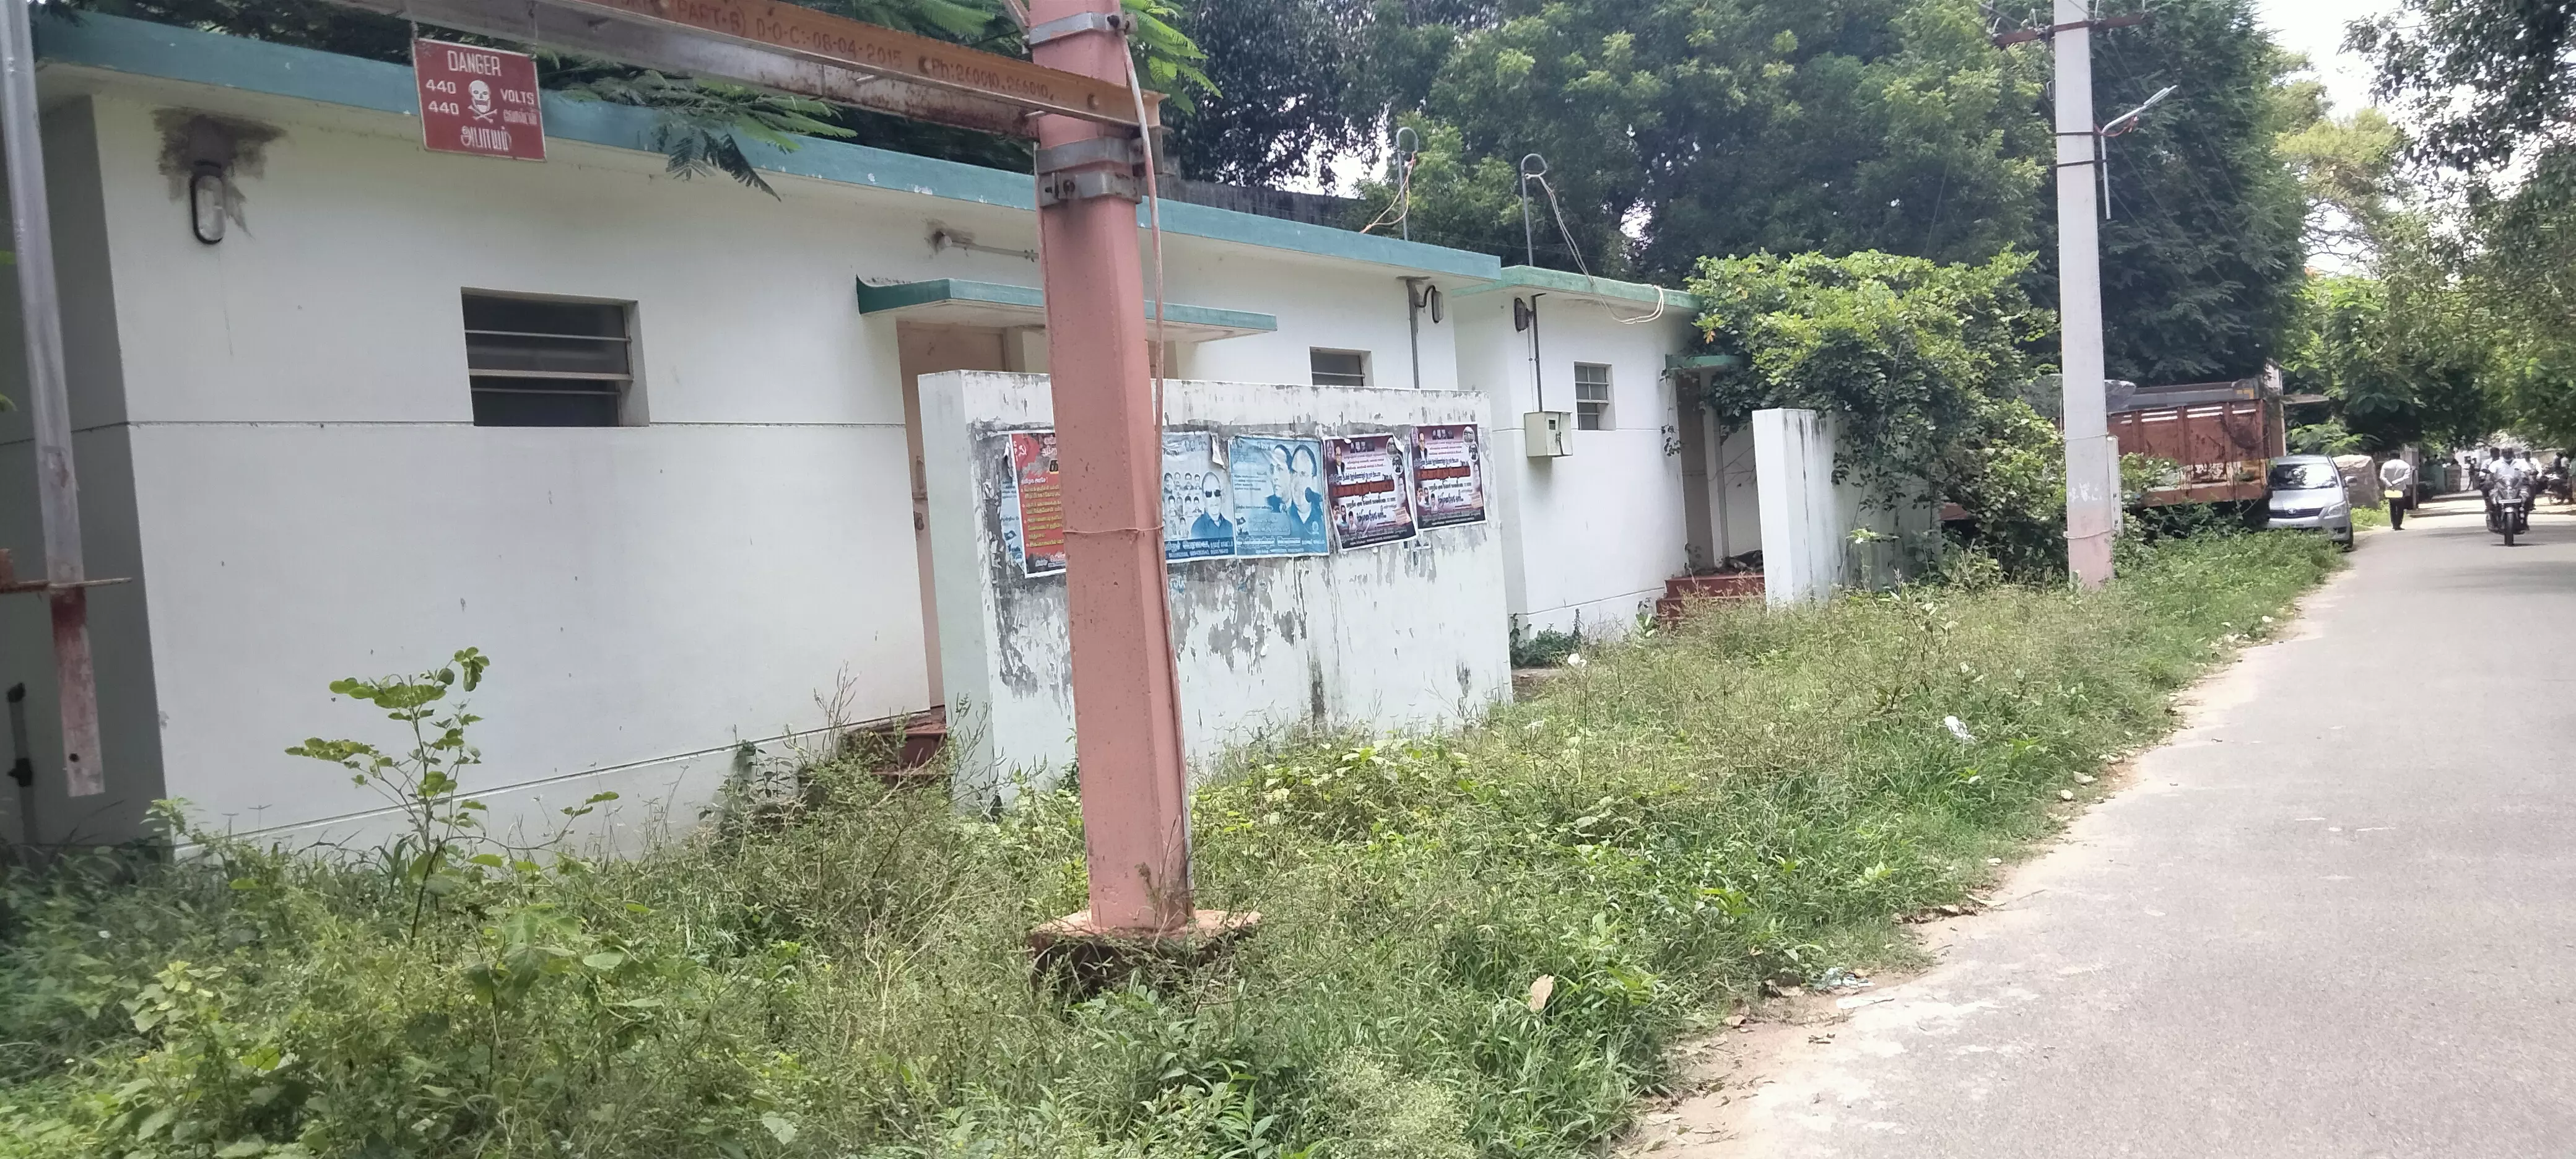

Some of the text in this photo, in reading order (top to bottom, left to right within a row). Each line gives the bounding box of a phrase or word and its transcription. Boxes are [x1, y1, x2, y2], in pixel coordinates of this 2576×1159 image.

[447, 50, 502, 77] DANGER
[425, 79, 535, 105] 440 VOLTS
[428, 100, 459, 115] 440
[460, 126, 512, 152] அபாயம்
